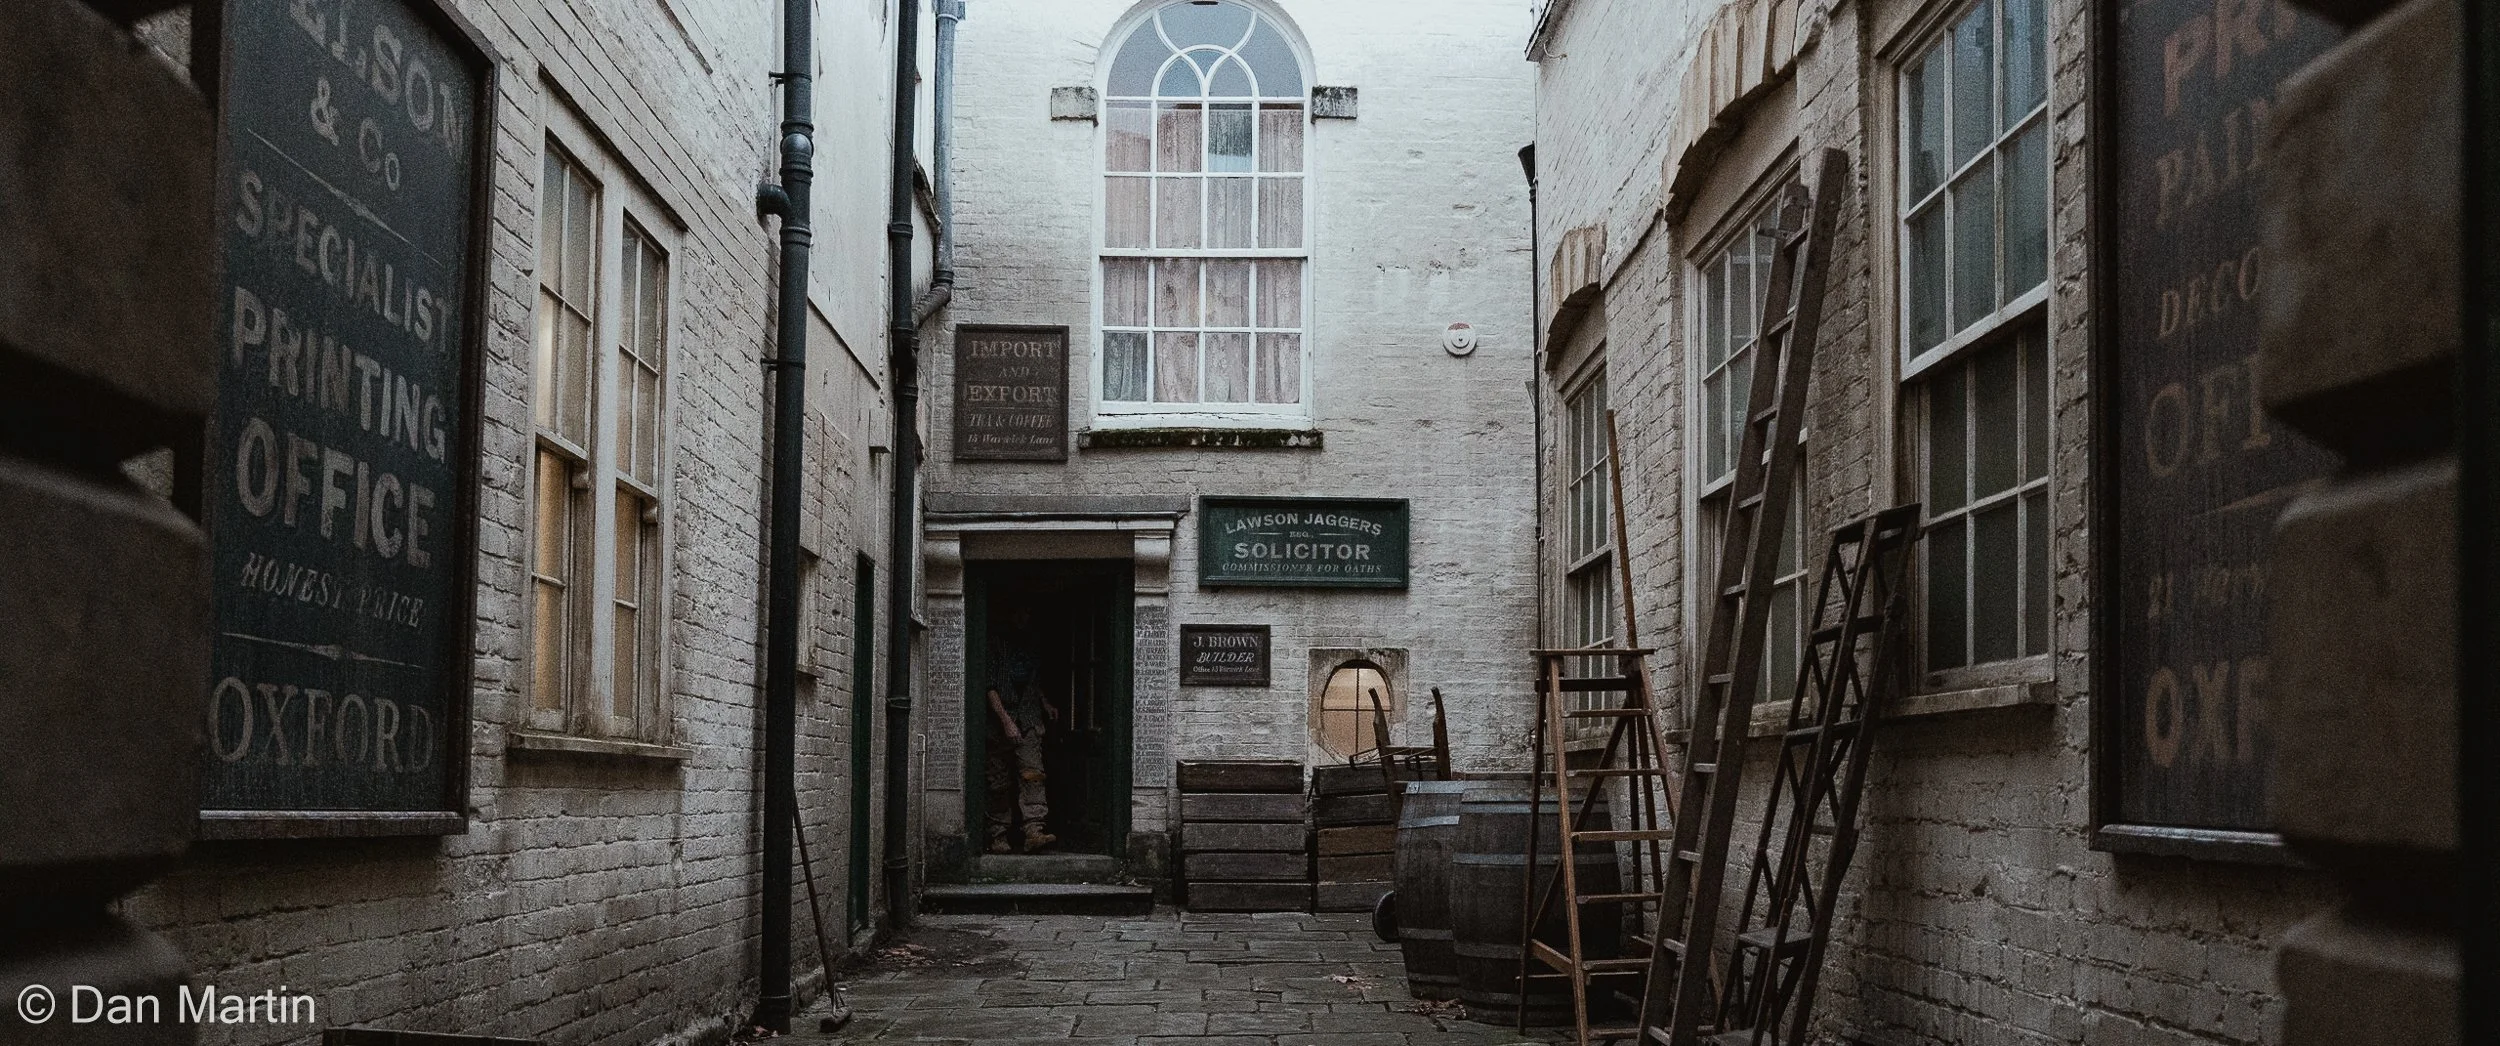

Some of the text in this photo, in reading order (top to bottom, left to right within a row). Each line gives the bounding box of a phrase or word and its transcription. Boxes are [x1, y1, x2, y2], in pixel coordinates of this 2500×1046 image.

[311, 76, 339, 146] &
[235, 170, 455, 353] SPECIALIST
[971, 341, 1055, 358] IMPORT
[233, 285, 446, 464] PRINTING
[998, 366, 1030, 378] AND
[968, 385, 1058, 403] EXPORT
[1009, 413, 1054, 428] COFFEE
[982, 434, 1027, 444] Warwick
[1029, 434, 1054, 444] Lane
[236, 417, 436, 568] OFFICE
[1225, 513, 1383, 537] LAWSON JAGGERS
[1234, 543, 1370, 560] SOLICITOR
[1222, 563, 1382, 573] COMMISSIONER FOR OATHS
[240, 552, 424, 628] HONEST PRICE
[1209, 636, 1259, 648] BROWN
[1196, 652, 1255, 663] BUILDER
[209, 676, 435, 774] OXFORD
